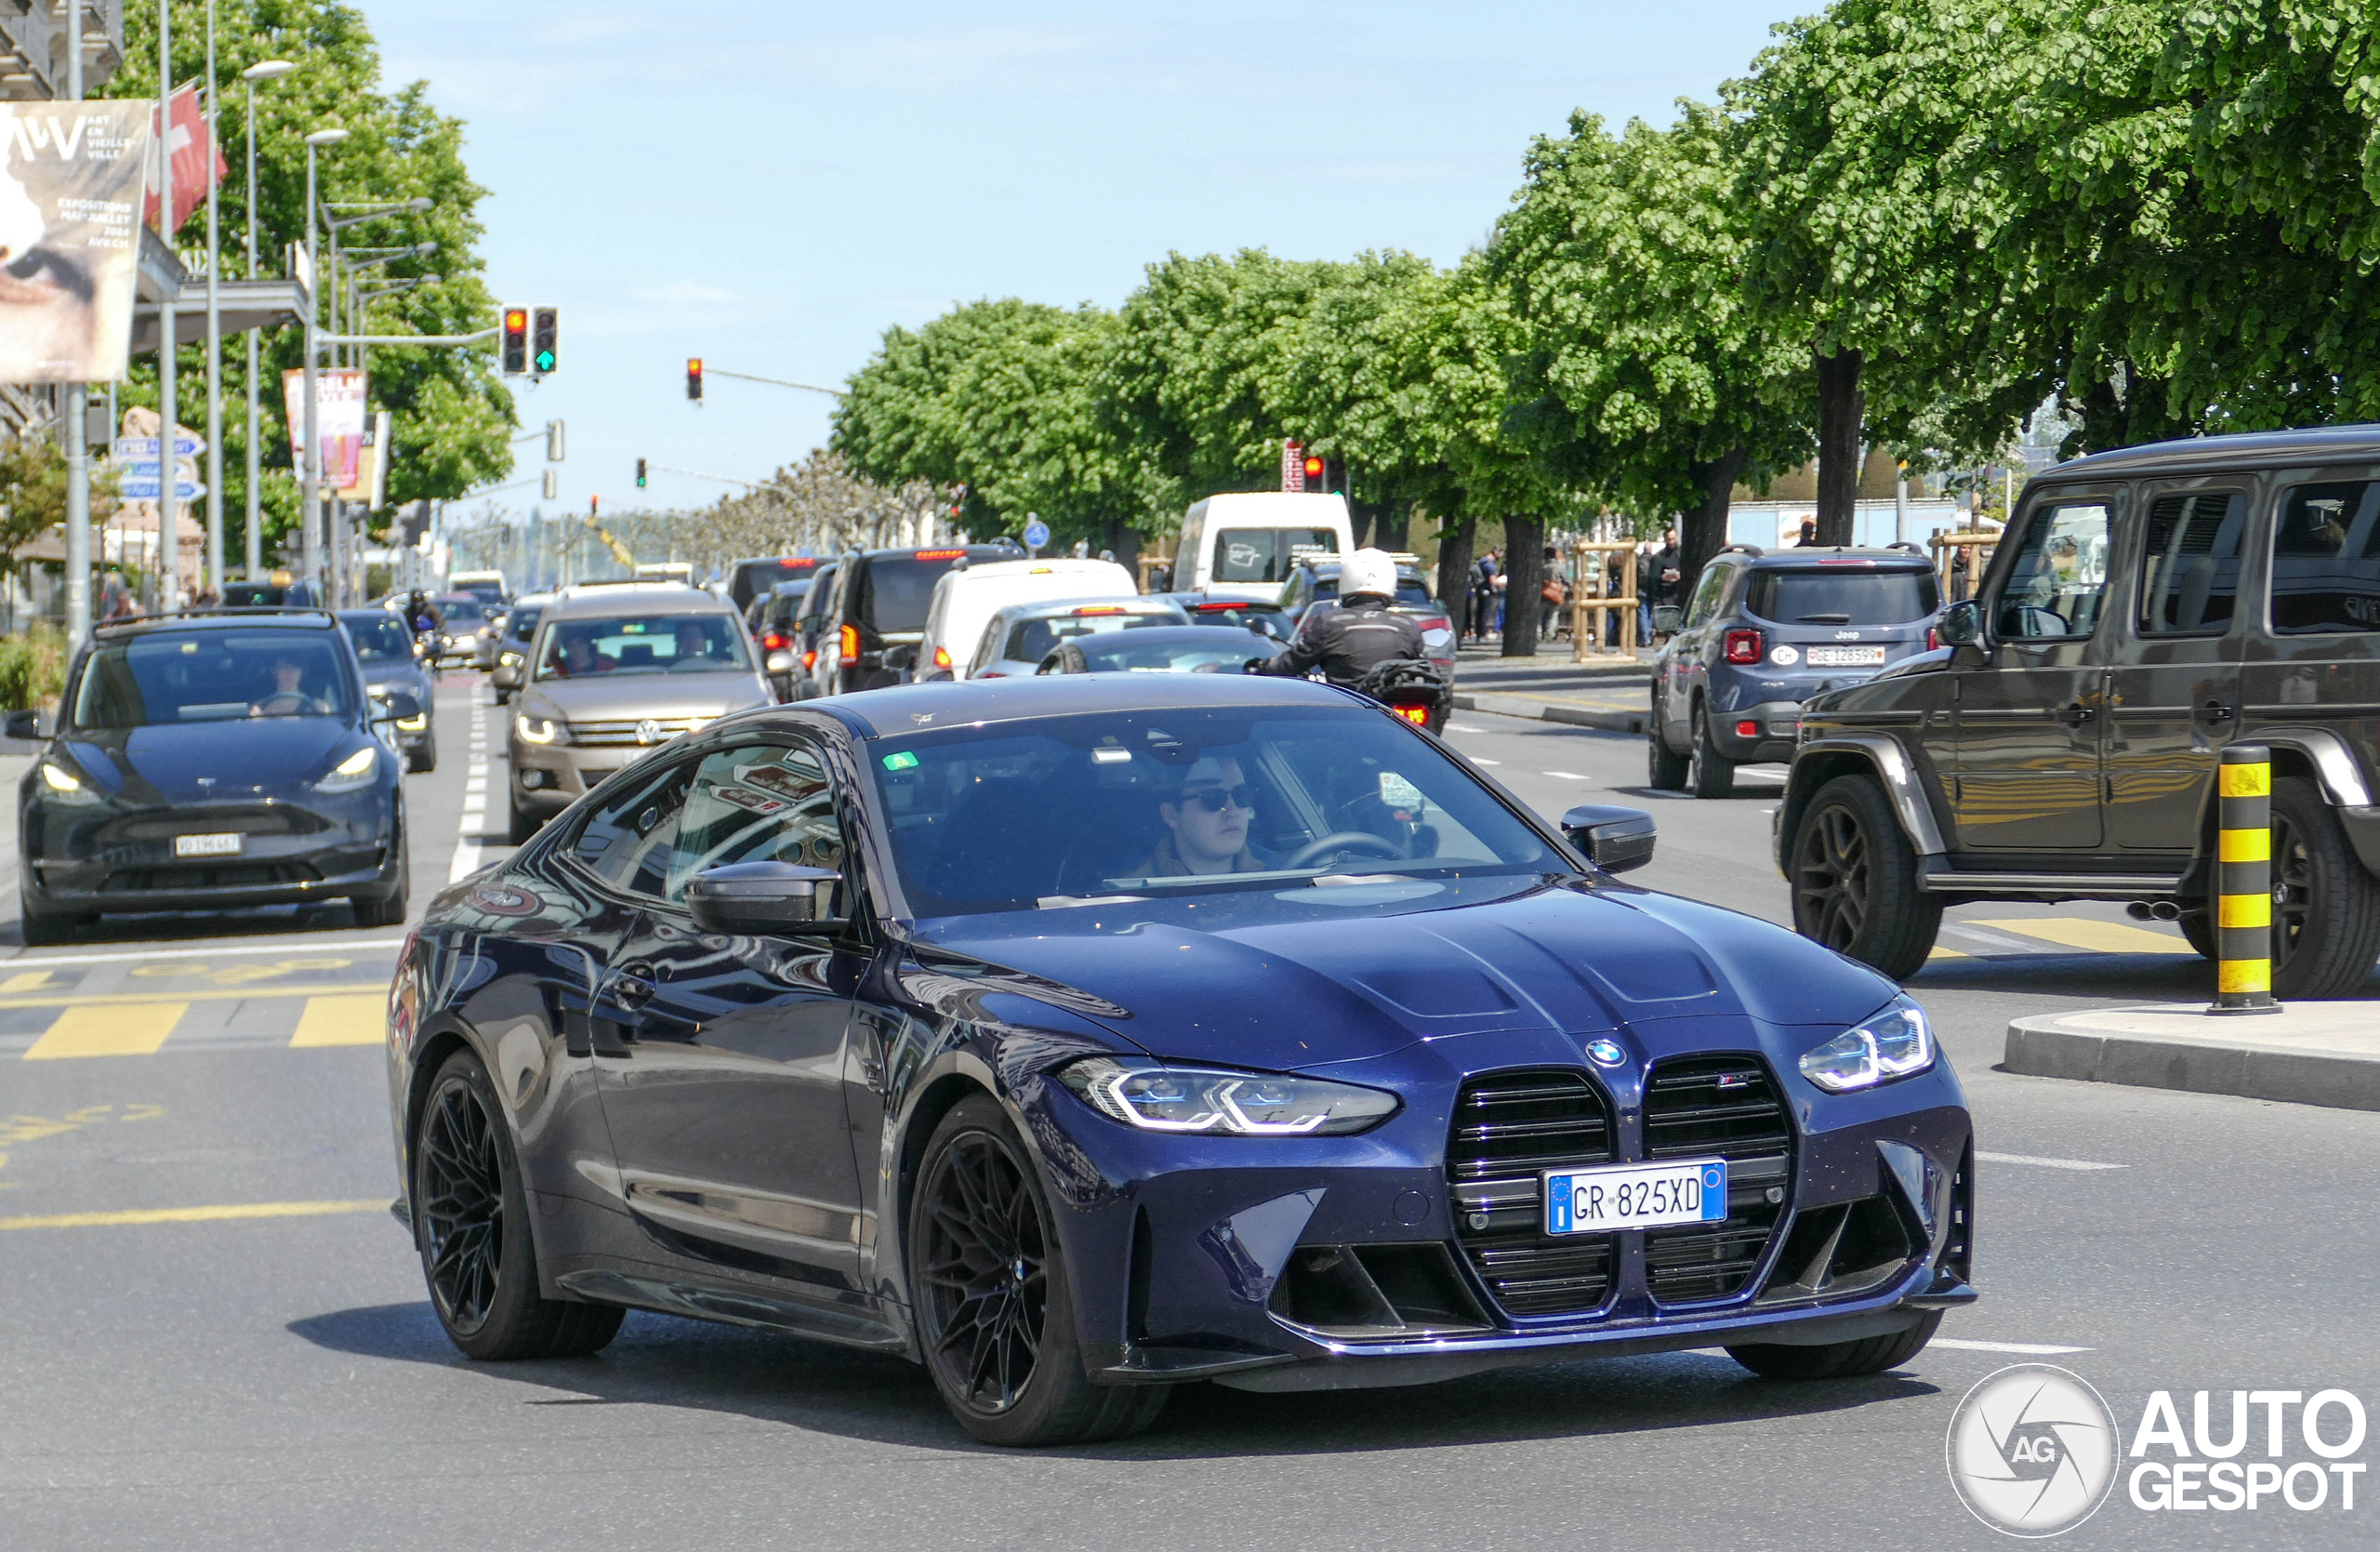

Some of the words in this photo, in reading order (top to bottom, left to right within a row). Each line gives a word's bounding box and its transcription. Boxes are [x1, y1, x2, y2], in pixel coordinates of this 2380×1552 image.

[87, 115, 110, 125] ART
[87, 126, 103, 137] EN
[87, 150, 121, 159] VILLE
[58, 197, 131, 213] EXPOSITIONS
[288, 375, 365, 391] ASELM
[1835, 630, 1859, 640] Jeep
[1778, 649, 1792, 662] CH
[1574, 1185, 1605, 1220] GR
[1619, 1177, 1699, 1216] 825XD
